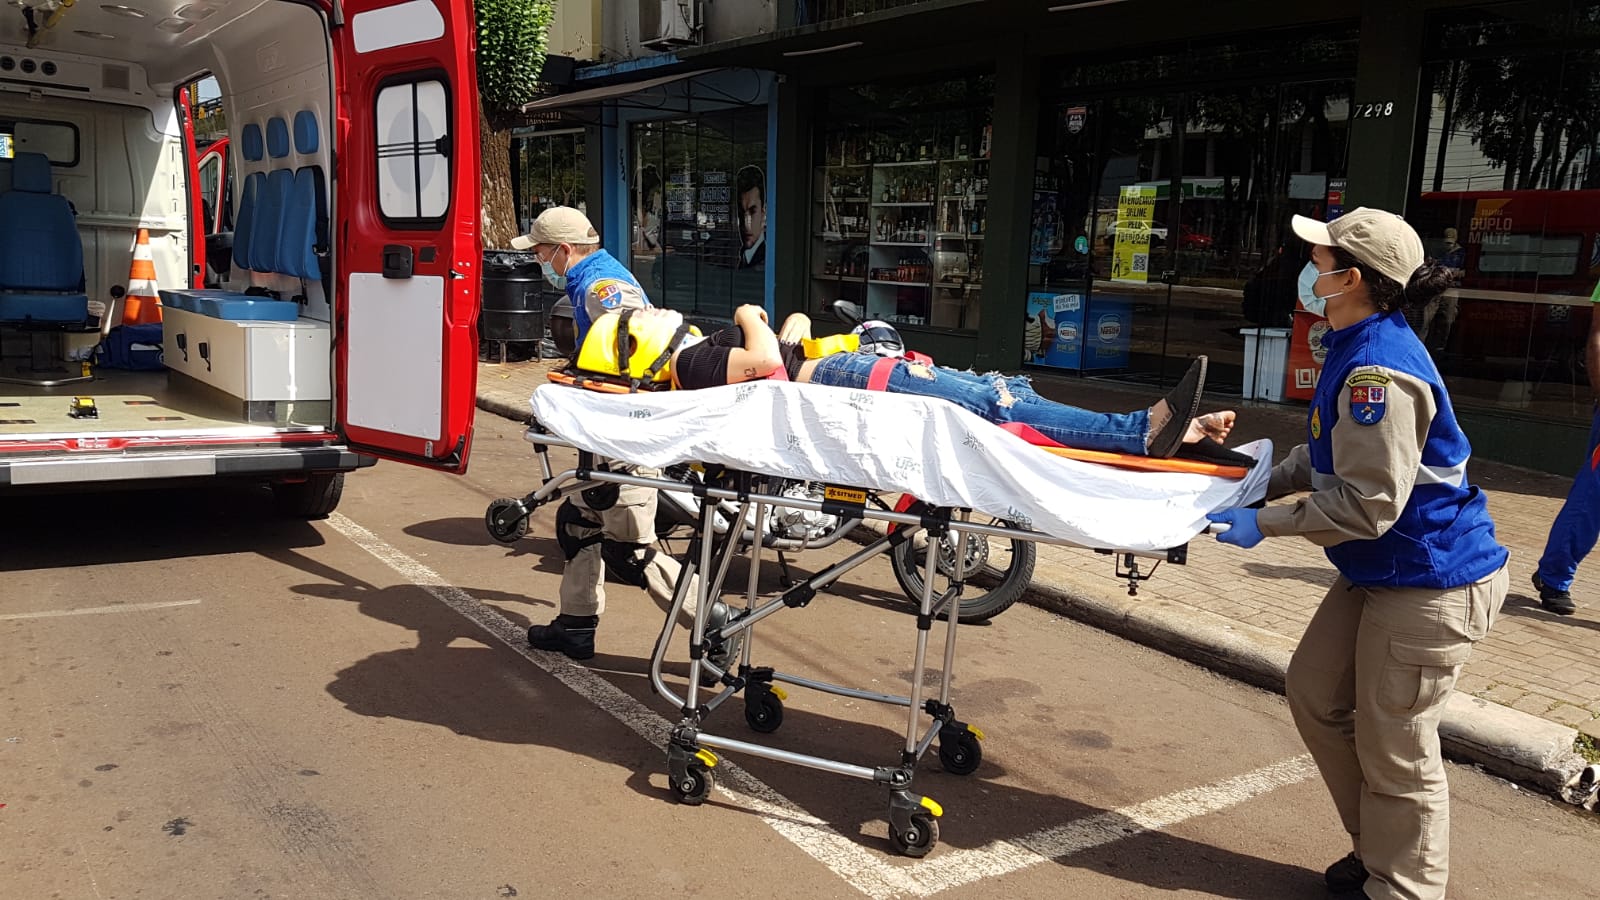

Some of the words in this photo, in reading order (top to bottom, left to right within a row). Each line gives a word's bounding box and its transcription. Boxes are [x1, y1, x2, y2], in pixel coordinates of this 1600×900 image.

[1354, 102, 1393, 118] 7298
[1120, 195, 1155, 206] ATENDEMOS
[1470, 217, 1513, 231] DUPLO
[1468, 231, 1511, 245] MALTE
[836, 491, 863, 500] SITMED
